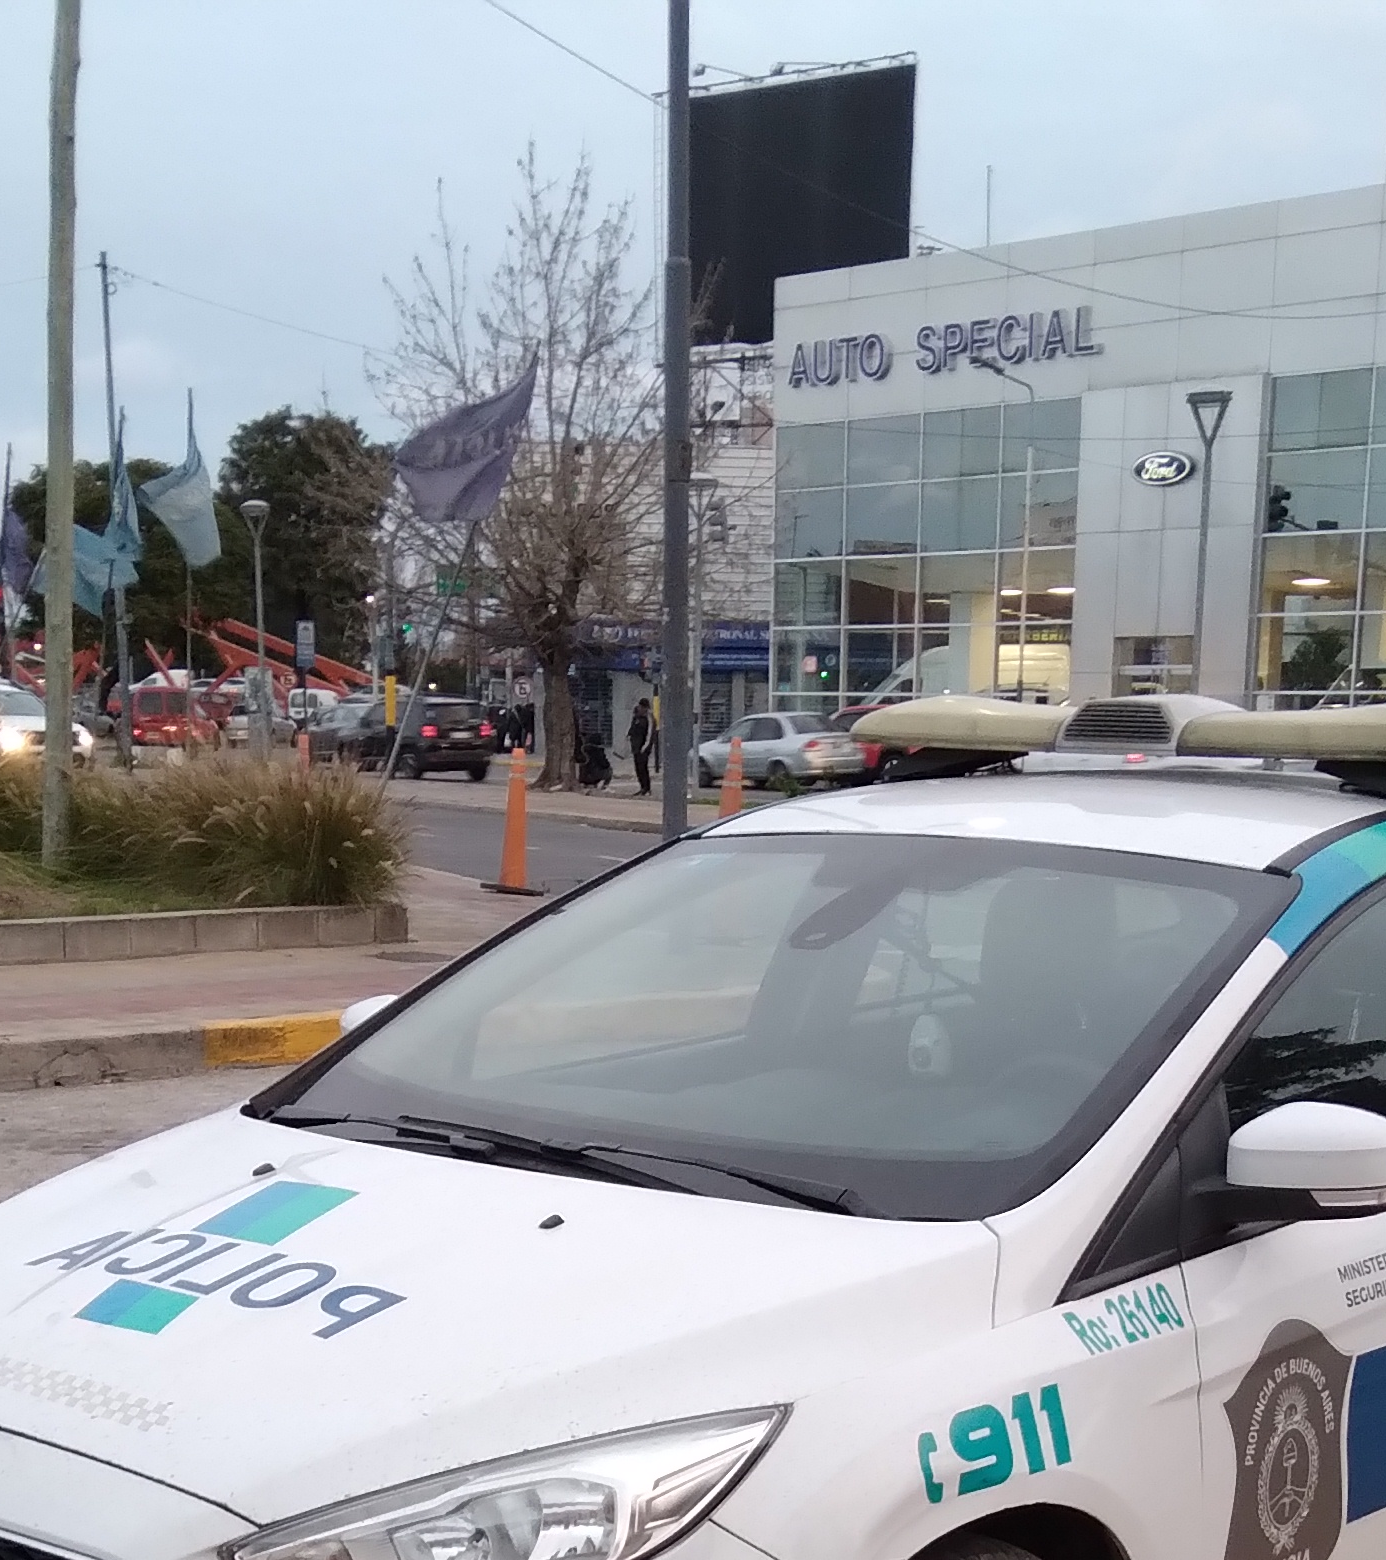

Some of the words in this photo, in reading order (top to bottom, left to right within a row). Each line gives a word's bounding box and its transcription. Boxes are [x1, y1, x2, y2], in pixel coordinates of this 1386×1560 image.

[788, 332, 893, 389] AUTO
[914, 305, 1105, 374] SPECIAL
[1104, 1282, 1185, 1344] 26140
[949, 1382, 1073, 1497] 911
[1244, 1377, 1276, 1466] PROVINCIA
[1274, 1362, 1288, 1383] DE
[1289, 1357, 1326, 1391] BUENOS
[1320, 1389, 1335, 1434] AIRES
